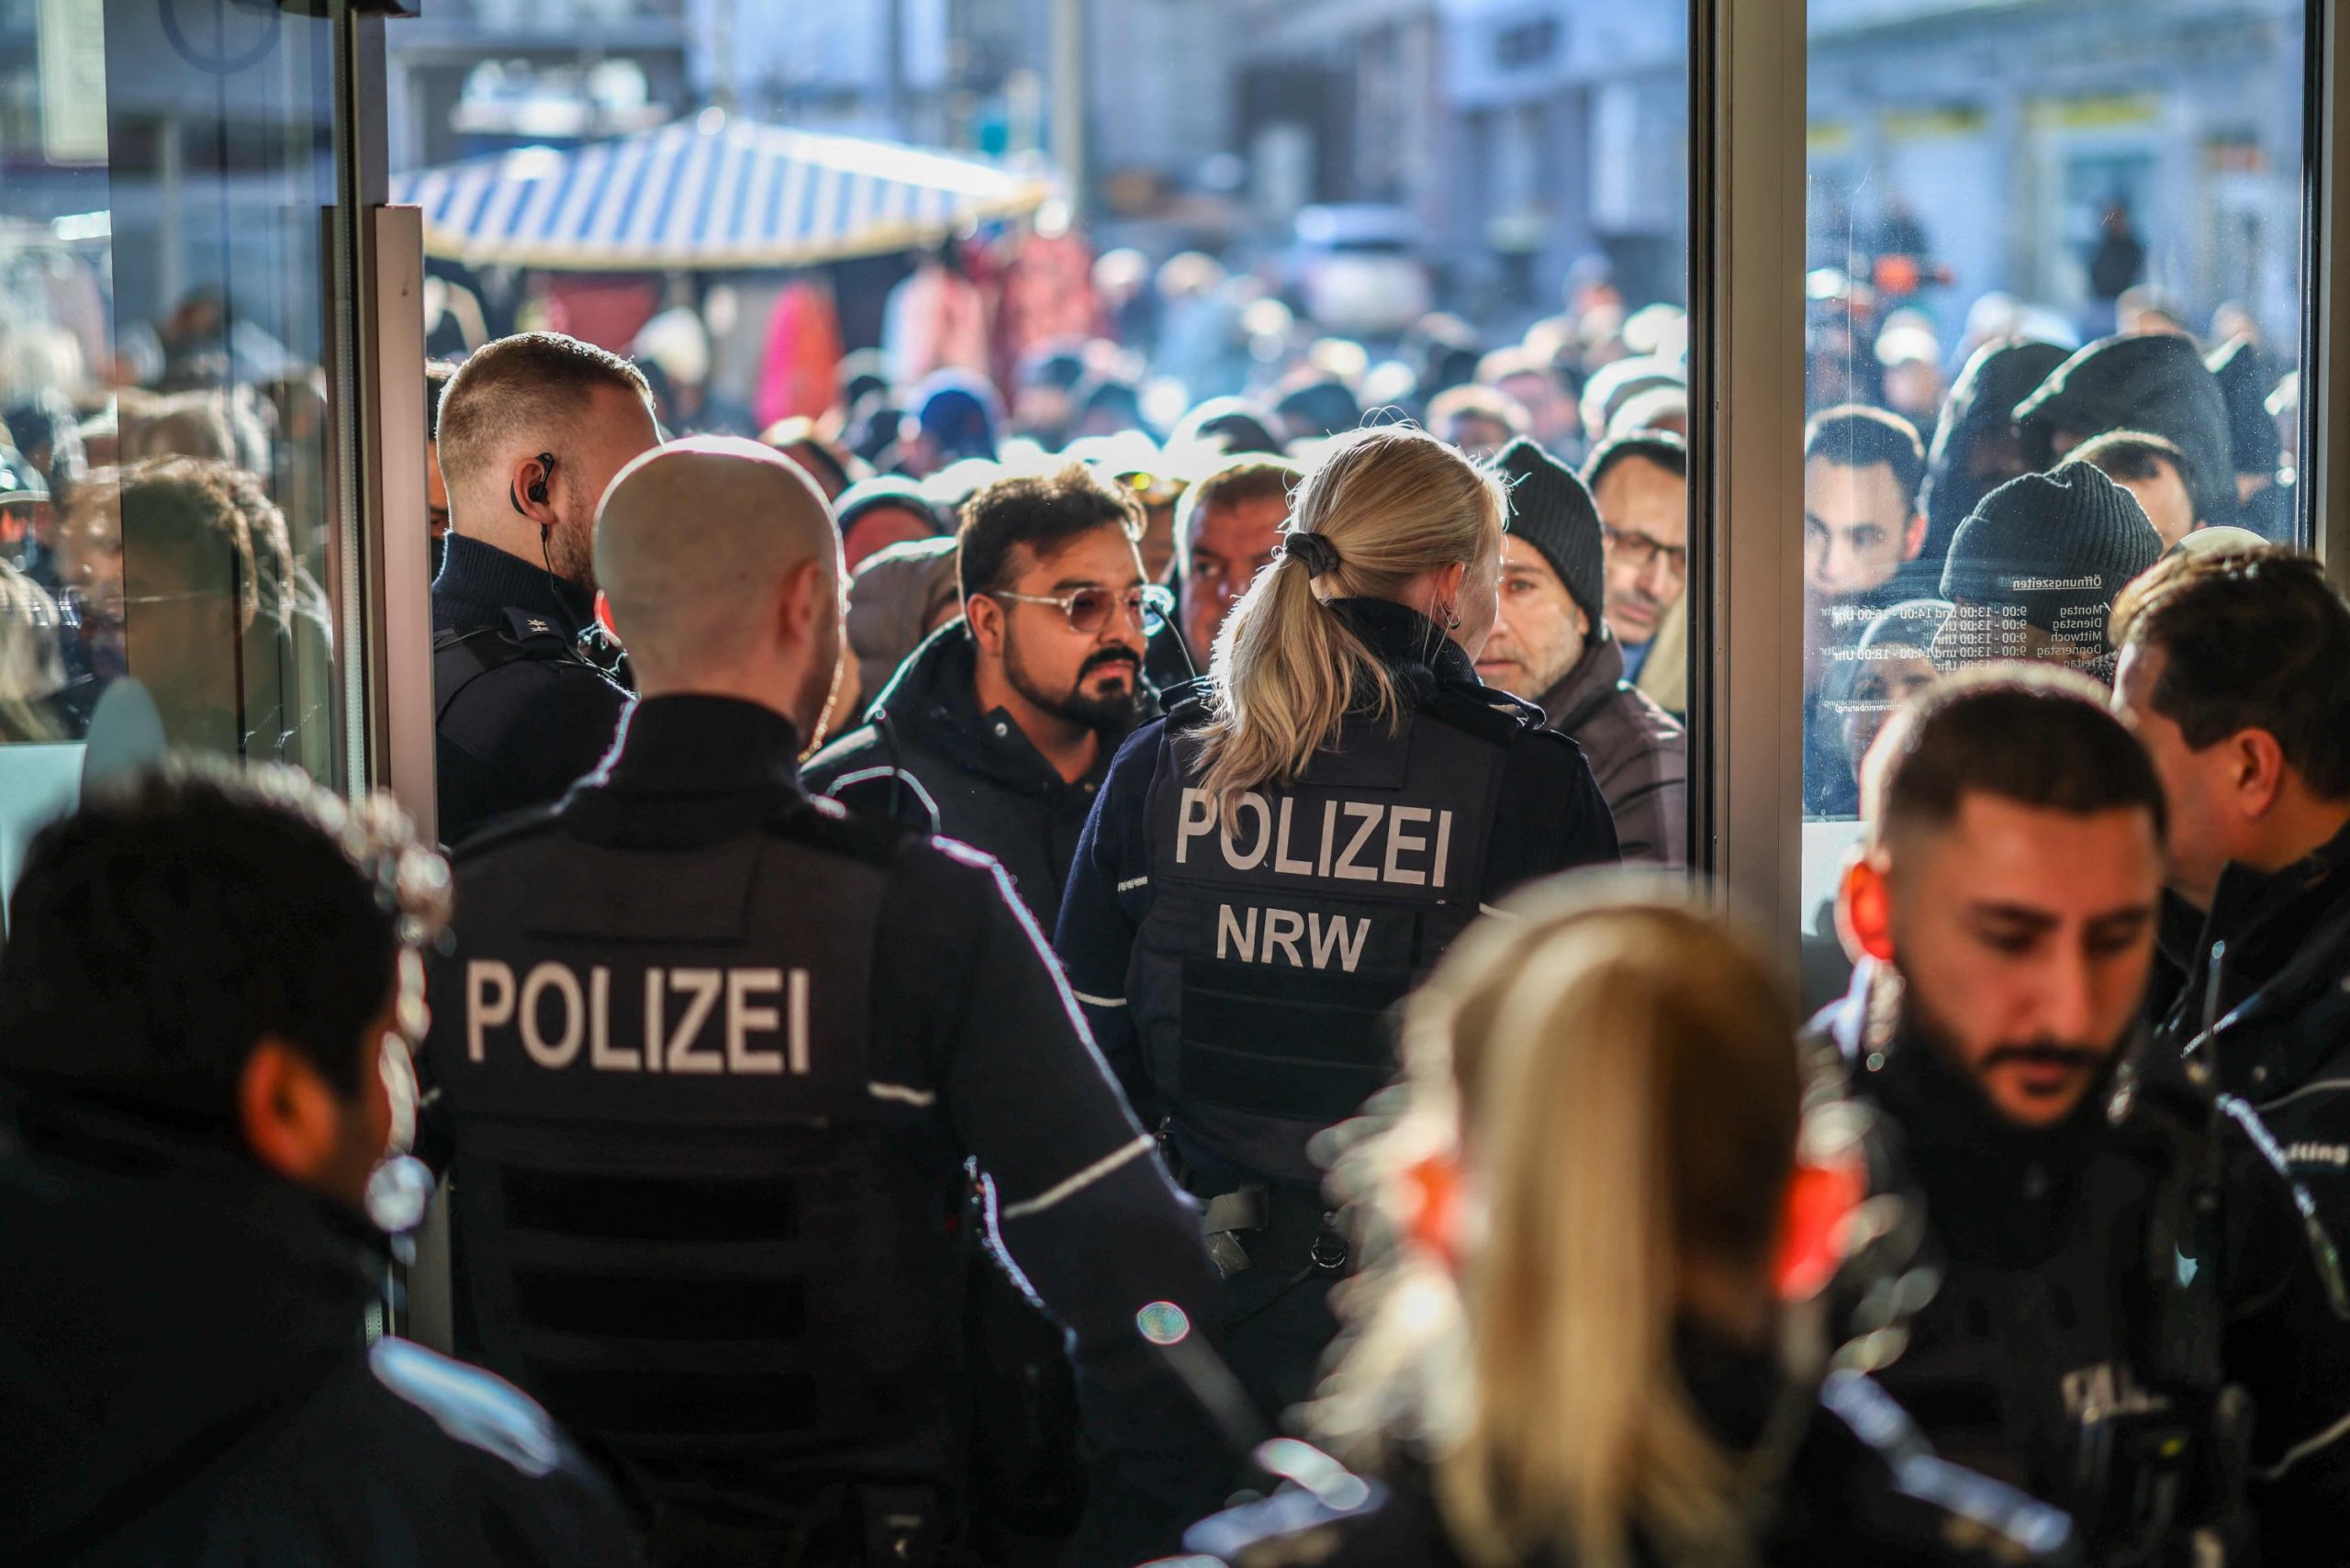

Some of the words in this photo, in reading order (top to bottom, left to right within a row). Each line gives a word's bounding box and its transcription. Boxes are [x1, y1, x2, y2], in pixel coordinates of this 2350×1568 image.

[1176, 788, 1453, 888] POLIZEI
[1216, 903, 1371, 973] NRW
[465, 958, 811, 1075] POLIZEI
